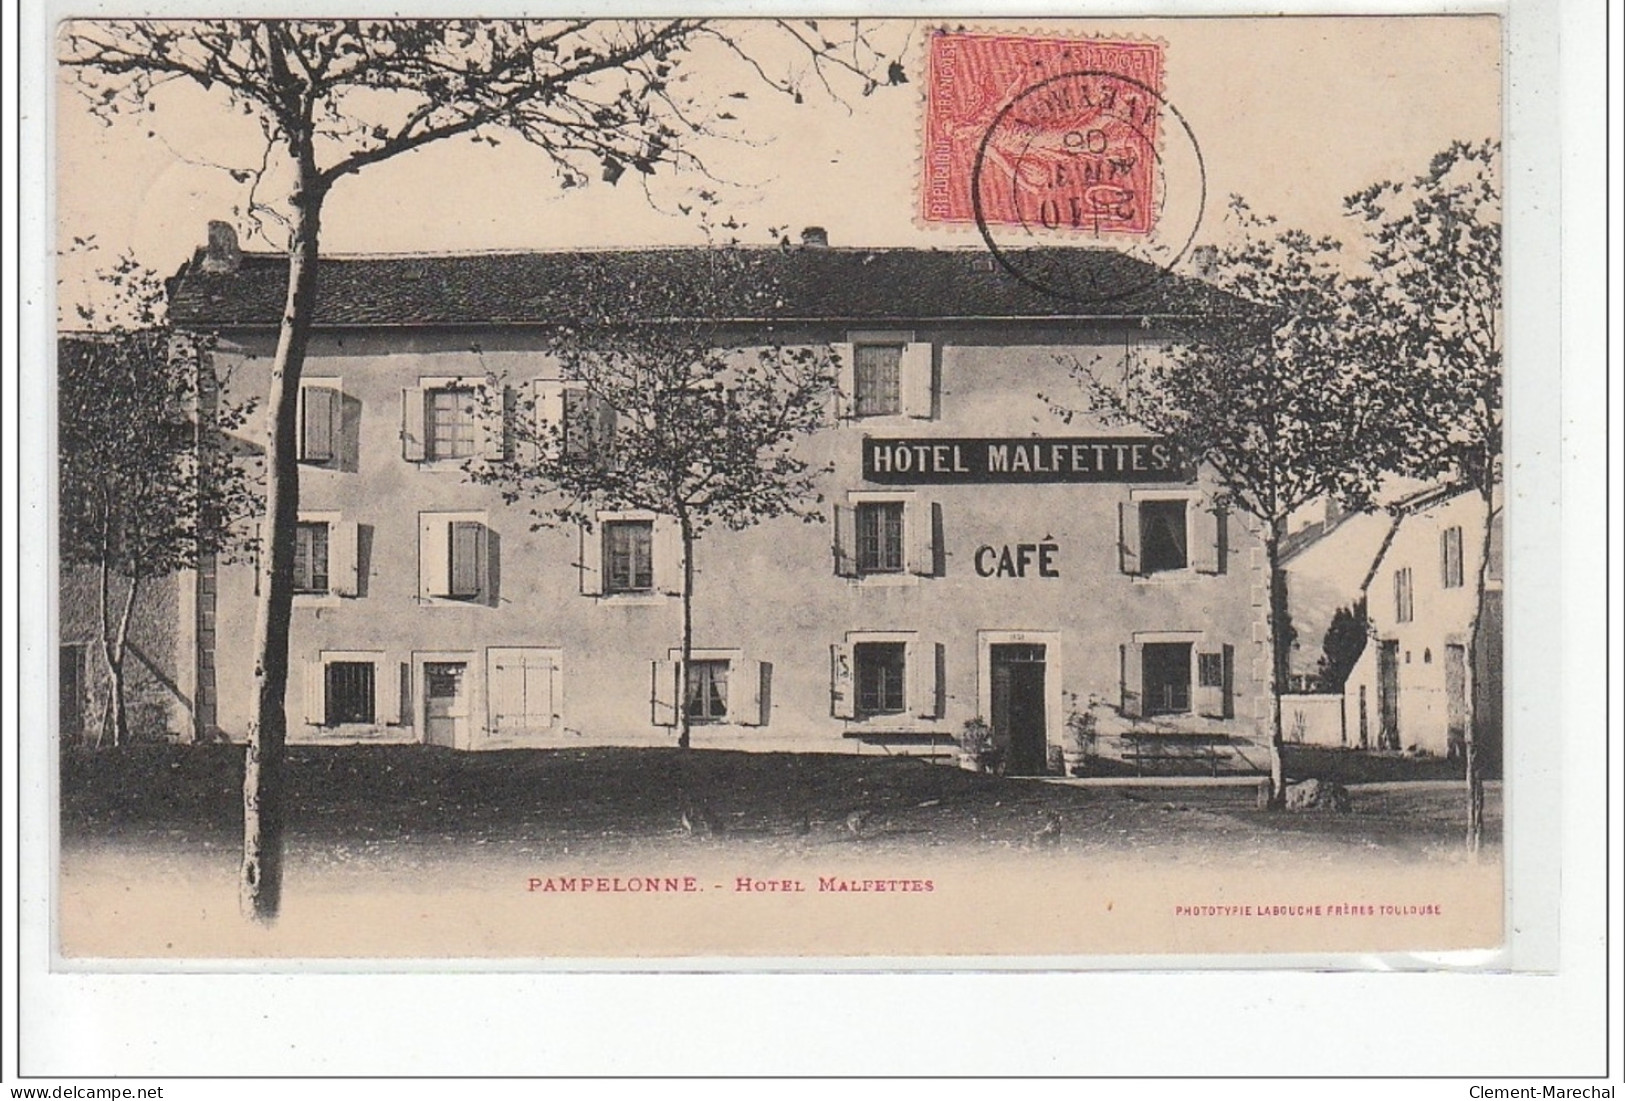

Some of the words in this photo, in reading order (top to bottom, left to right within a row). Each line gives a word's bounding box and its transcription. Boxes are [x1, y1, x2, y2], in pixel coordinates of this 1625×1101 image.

[872, 440, 970, 473] HÔTEL
[987, 443, 1166, 473] MALFETTES
[974, 534, 1060, 578] CAFÉ
